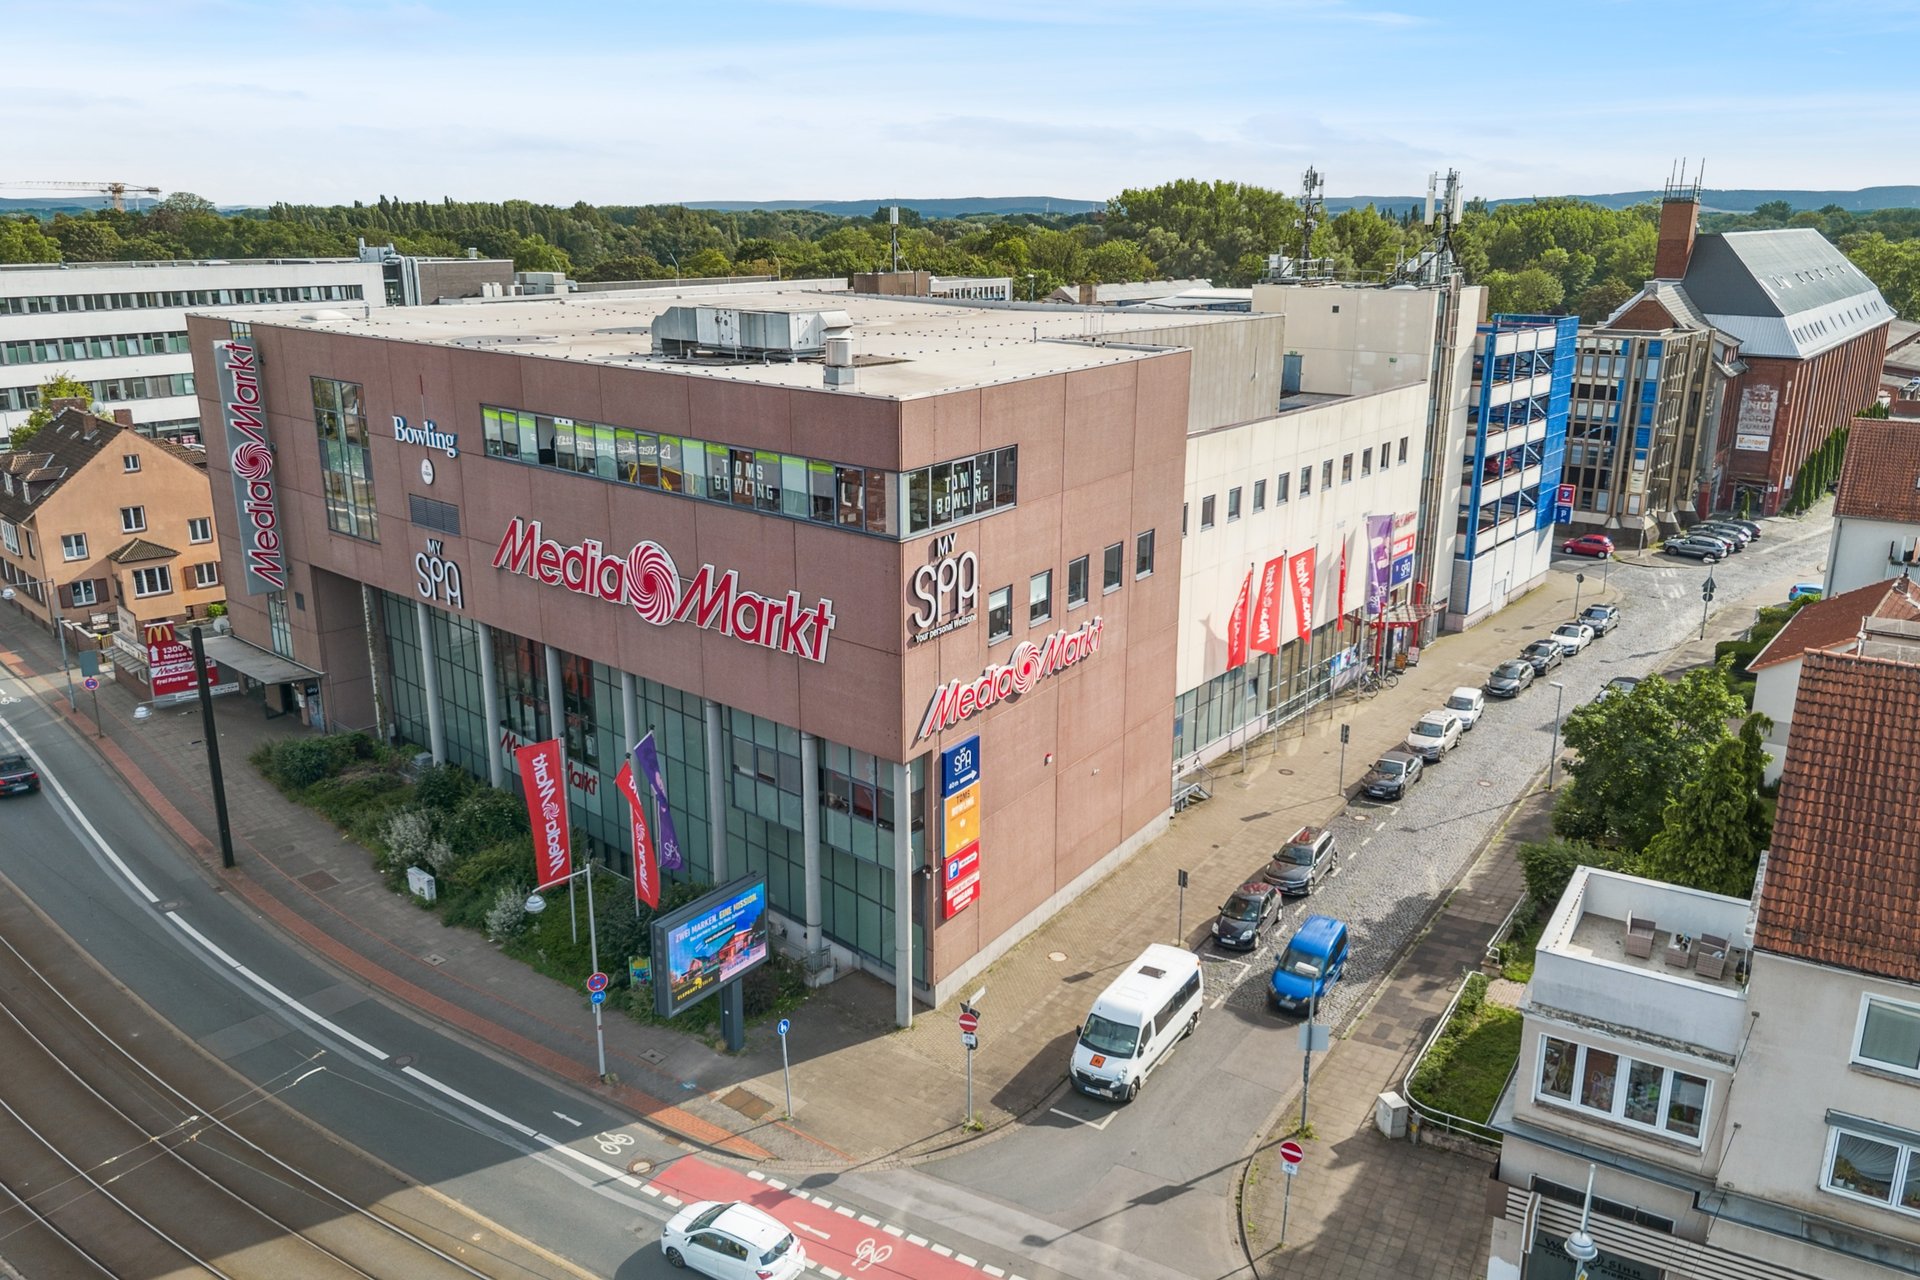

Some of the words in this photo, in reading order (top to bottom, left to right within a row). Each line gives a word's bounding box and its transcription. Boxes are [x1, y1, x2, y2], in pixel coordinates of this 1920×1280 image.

[225, 340, 264, 442] Markt
[392, 415, 458, 459] Bowling
[722, 459, 764, 481] TOMS
[944, 469, 981, 492] TOMS
[714, 474, 773, 501] BOWLING
[936, 485, 989, 514] BOWLING
[246, 480, 285, 589] Media
[427, 538, 443, 555] MY
[935, 533, 957, 557] MY
[415, 552, 464, 609] SPA
[492, 516, 628, 605] Media
[674, 564, 835, 663] Markt
[913, 551, 979, 628] SPA
[162, 645, 184, 654] 1300
[156, 665, 183, 676] Media
[919, 663, 1014, 739] Media
[1038, 615, 1103, 680] Markt
[954, 750, 972, 772] SPA
[949, 862, 958, 878] P
